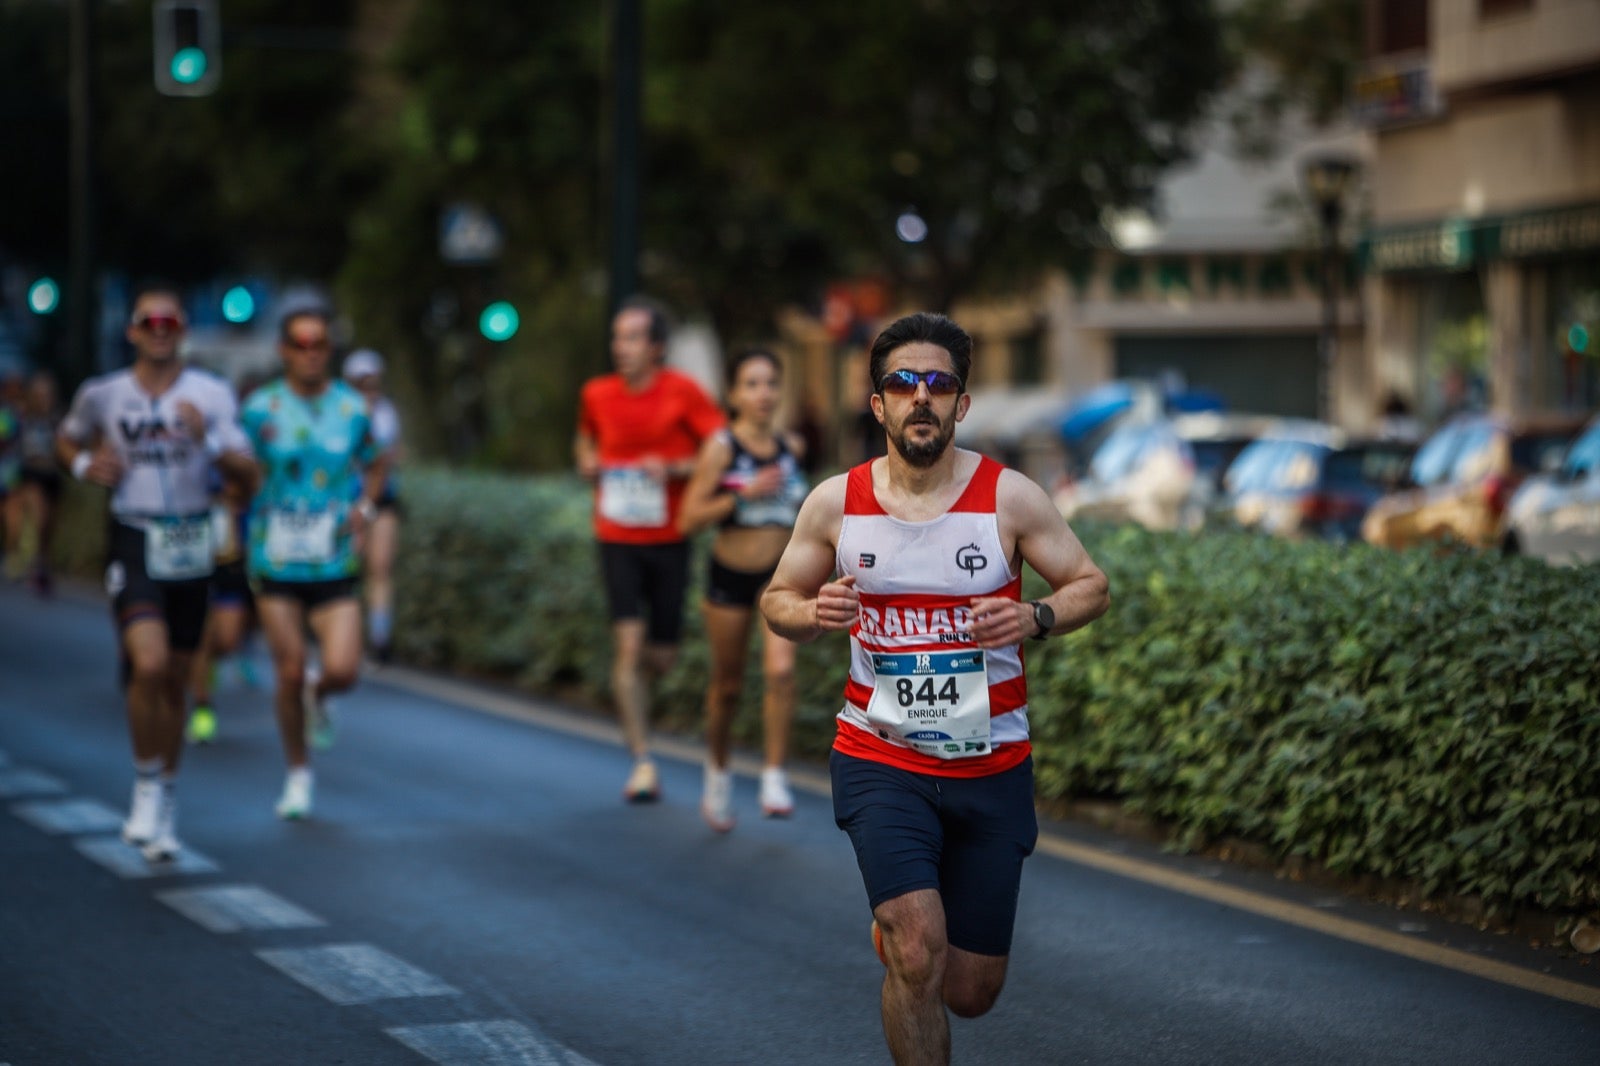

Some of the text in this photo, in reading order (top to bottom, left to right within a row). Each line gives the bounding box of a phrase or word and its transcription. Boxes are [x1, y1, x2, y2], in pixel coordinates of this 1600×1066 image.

[939, 632, 959, 643] RUN
[896, 676, 960, 707] 844
[907, 708, 948, 719] ENRIQUE
